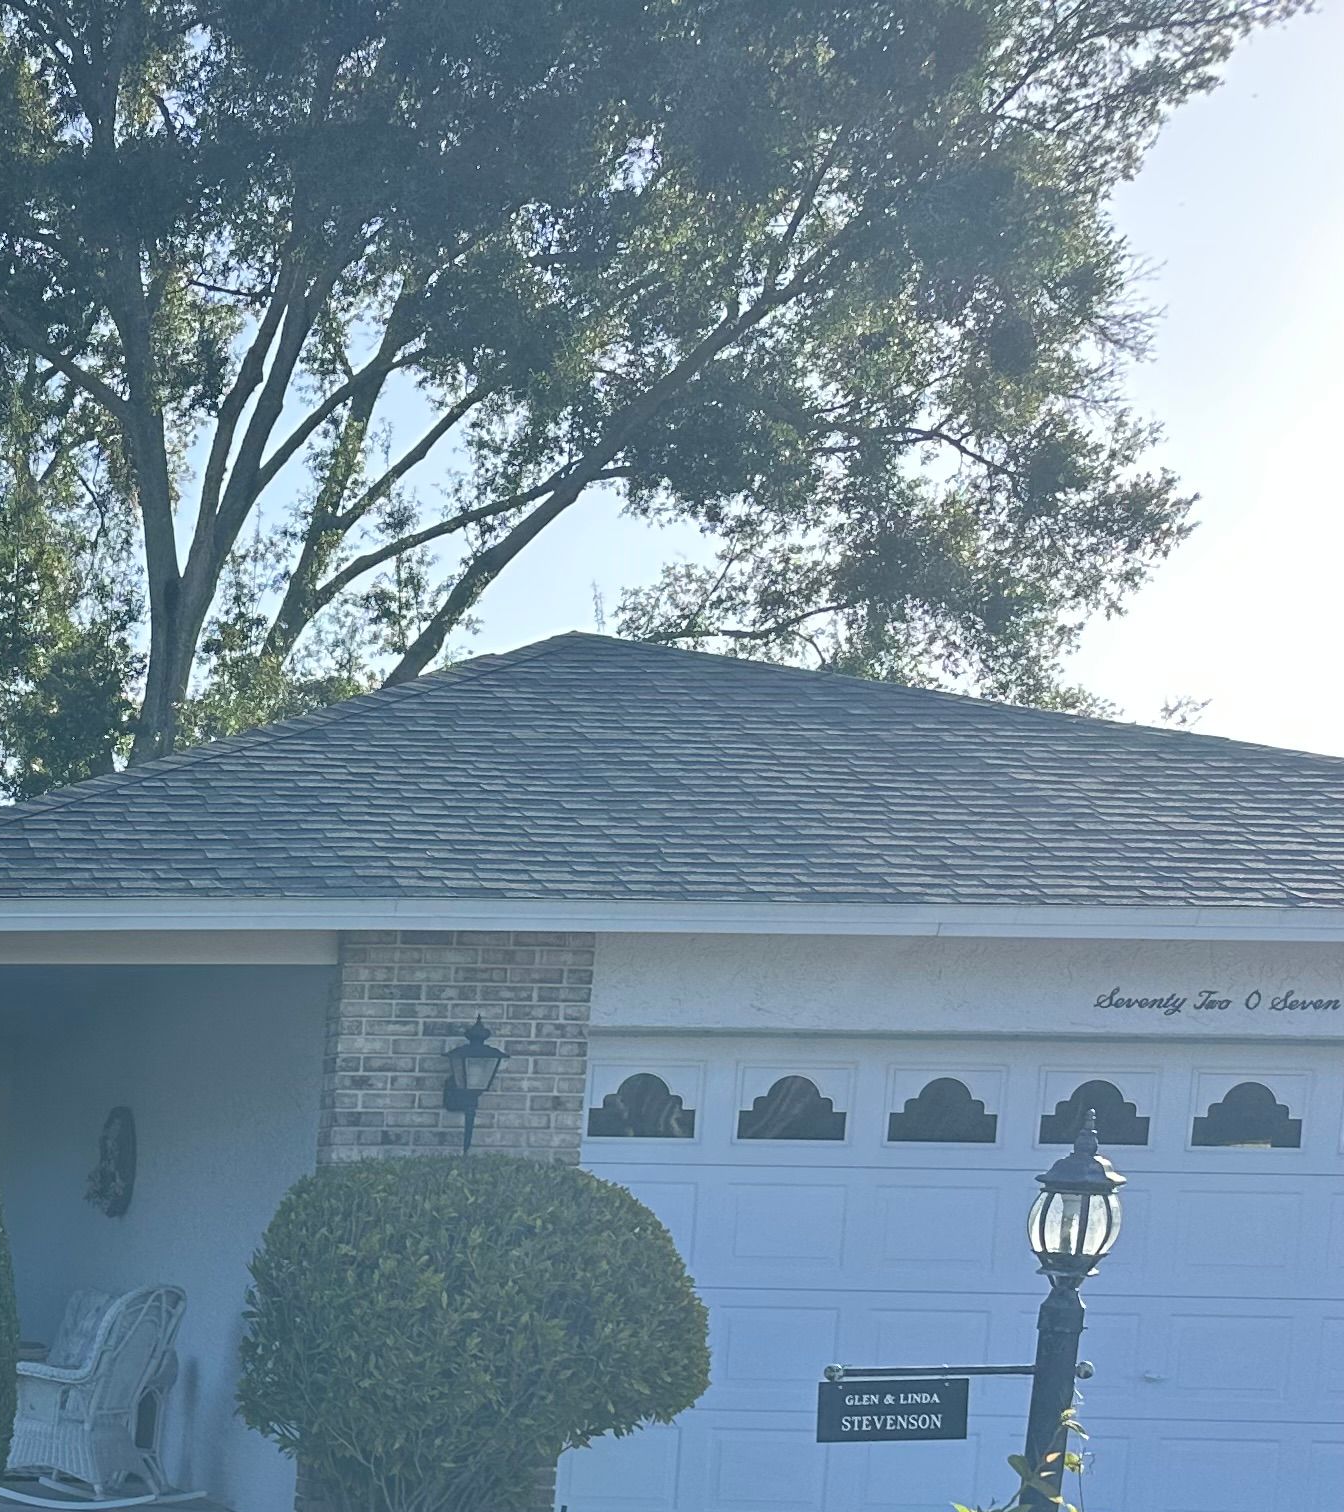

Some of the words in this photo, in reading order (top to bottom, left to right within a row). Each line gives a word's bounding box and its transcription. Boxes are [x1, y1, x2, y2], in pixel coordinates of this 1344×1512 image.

[1093, 986, 1188, 1016] Seventy
[1193, 990, 1233, 1011] Two
[1268, 990, 1342, 1011] Seven
[845, 1394, 879, 1406] GLEN
[883, 1394, 895, 1405] &
[899, 1393, 940, 1404] LINDA
[841, 1414, 943, 1432] STEVENSON
